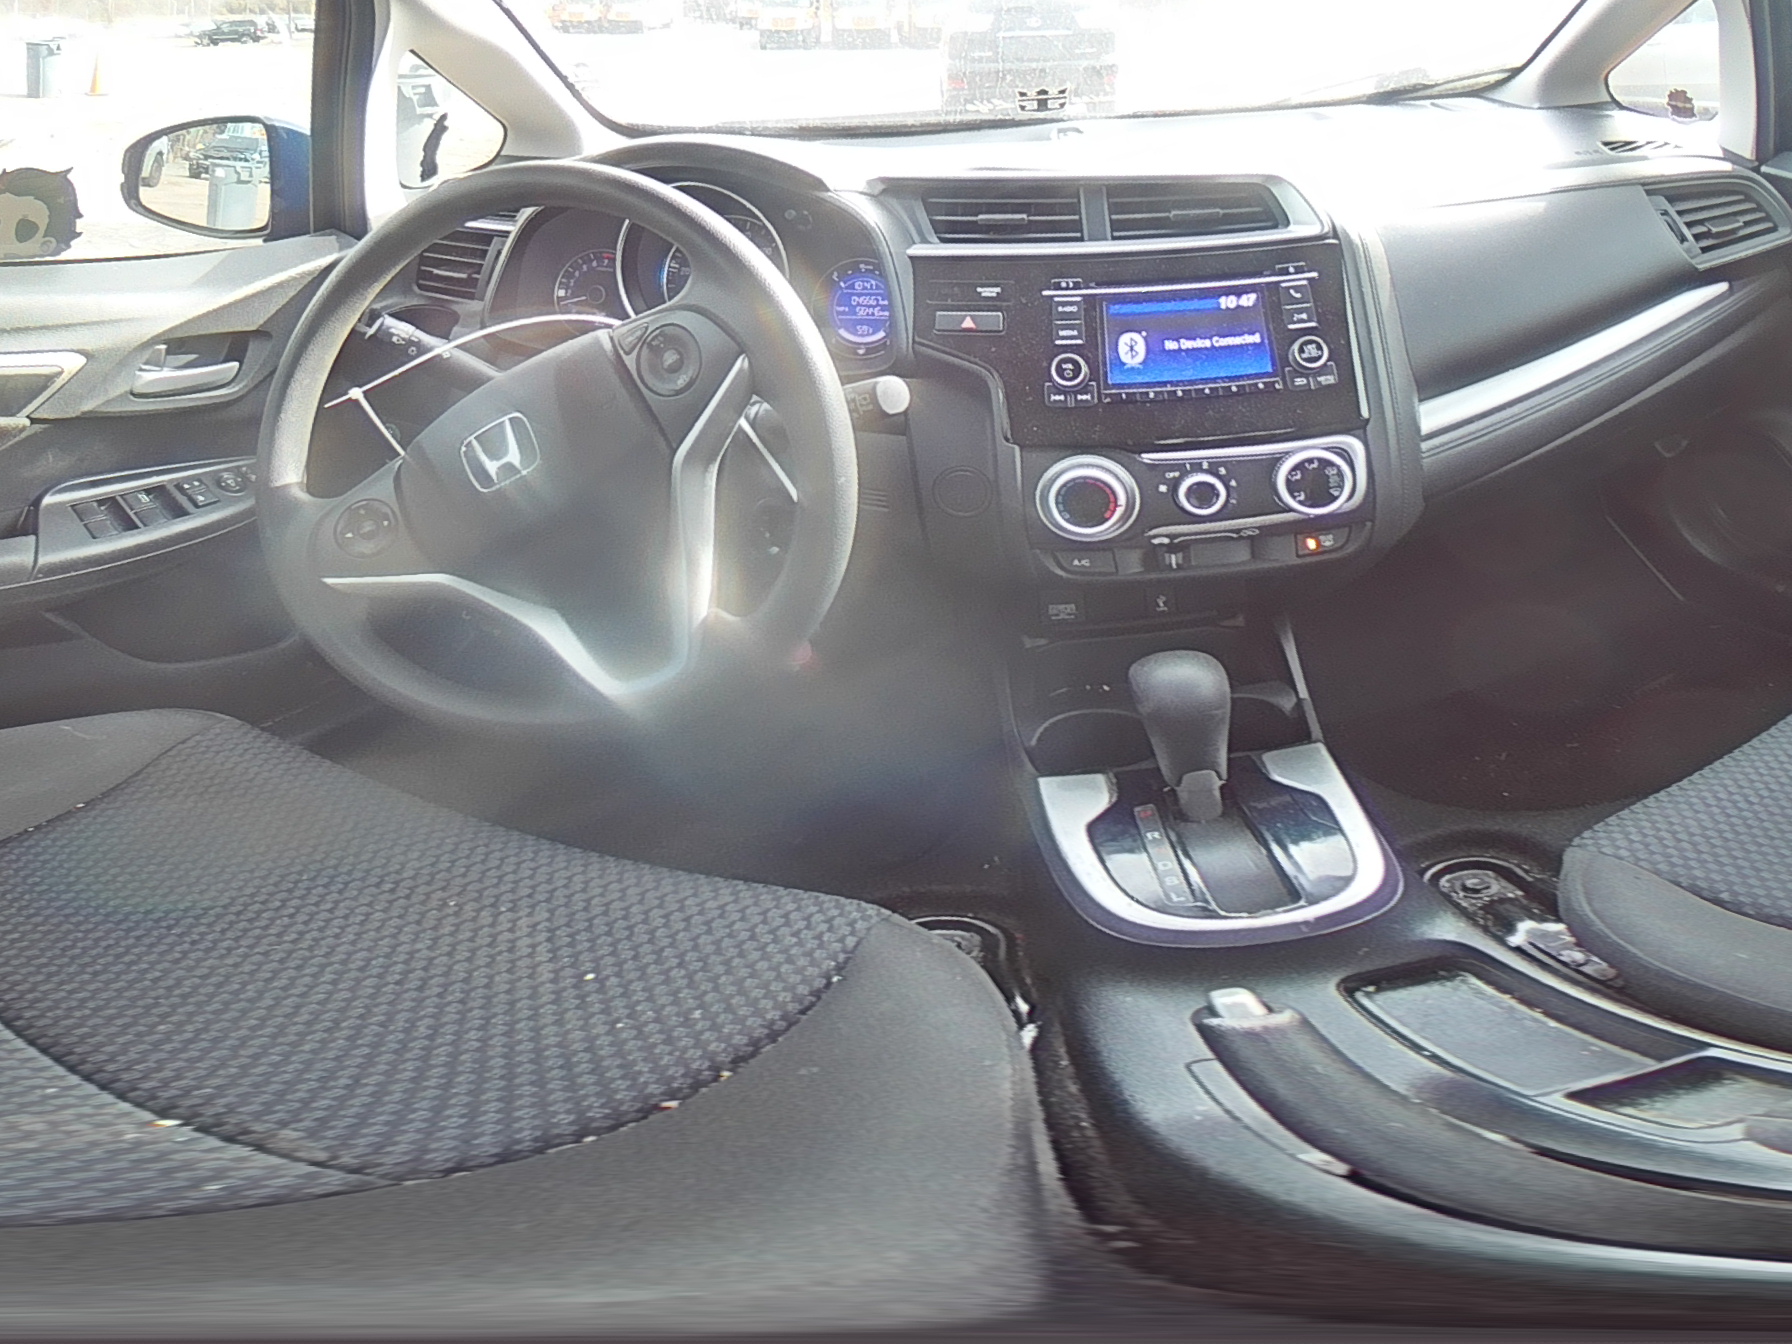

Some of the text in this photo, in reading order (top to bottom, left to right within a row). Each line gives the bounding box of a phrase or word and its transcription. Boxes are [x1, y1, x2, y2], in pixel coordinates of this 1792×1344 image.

[1164, 332, 1261, 351] No Device Connected
[1073, 558, 1090, 566] A/C
[1146, 831, 1162, 840] R
[1170, 892, 1186, 902] L
